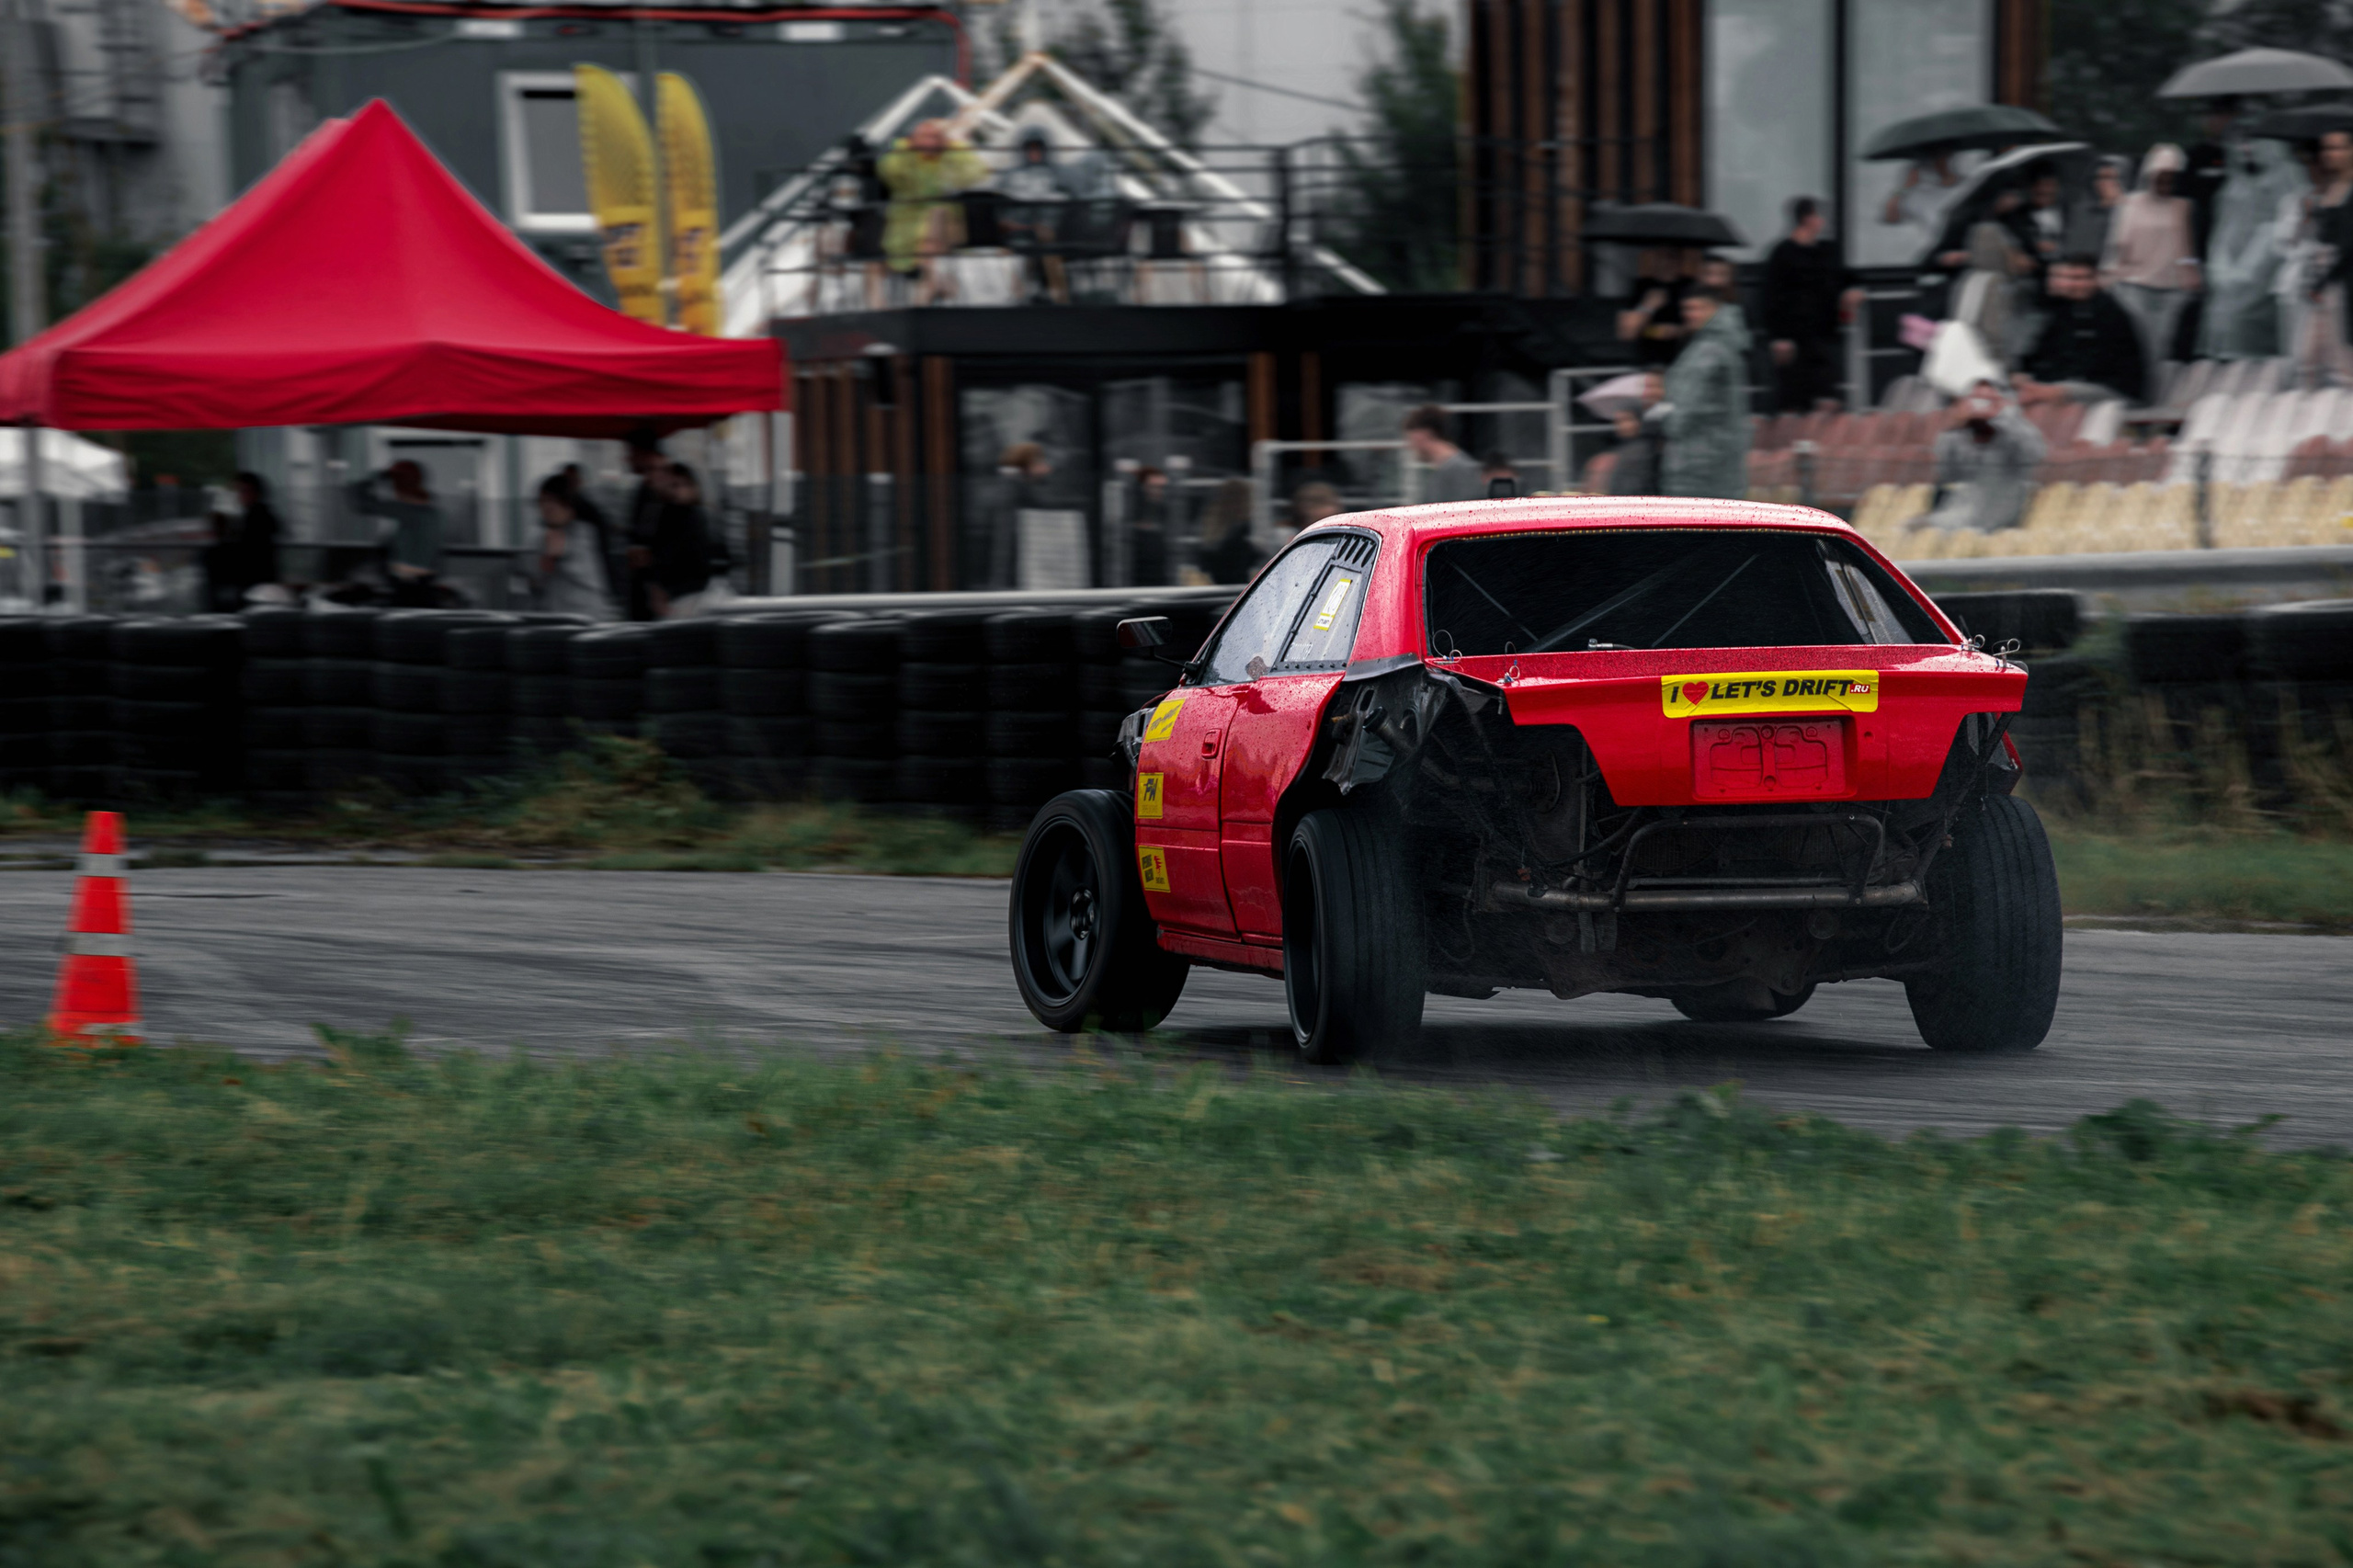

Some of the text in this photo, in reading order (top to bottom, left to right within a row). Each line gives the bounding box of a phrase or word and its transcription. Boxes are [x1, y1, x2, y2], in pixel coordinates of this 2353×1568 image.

[1670, 686, 1678, 703] I
[1711, 680, 1776, 699] LET'S
[1782, 679, 1853, 697] DRIFT
